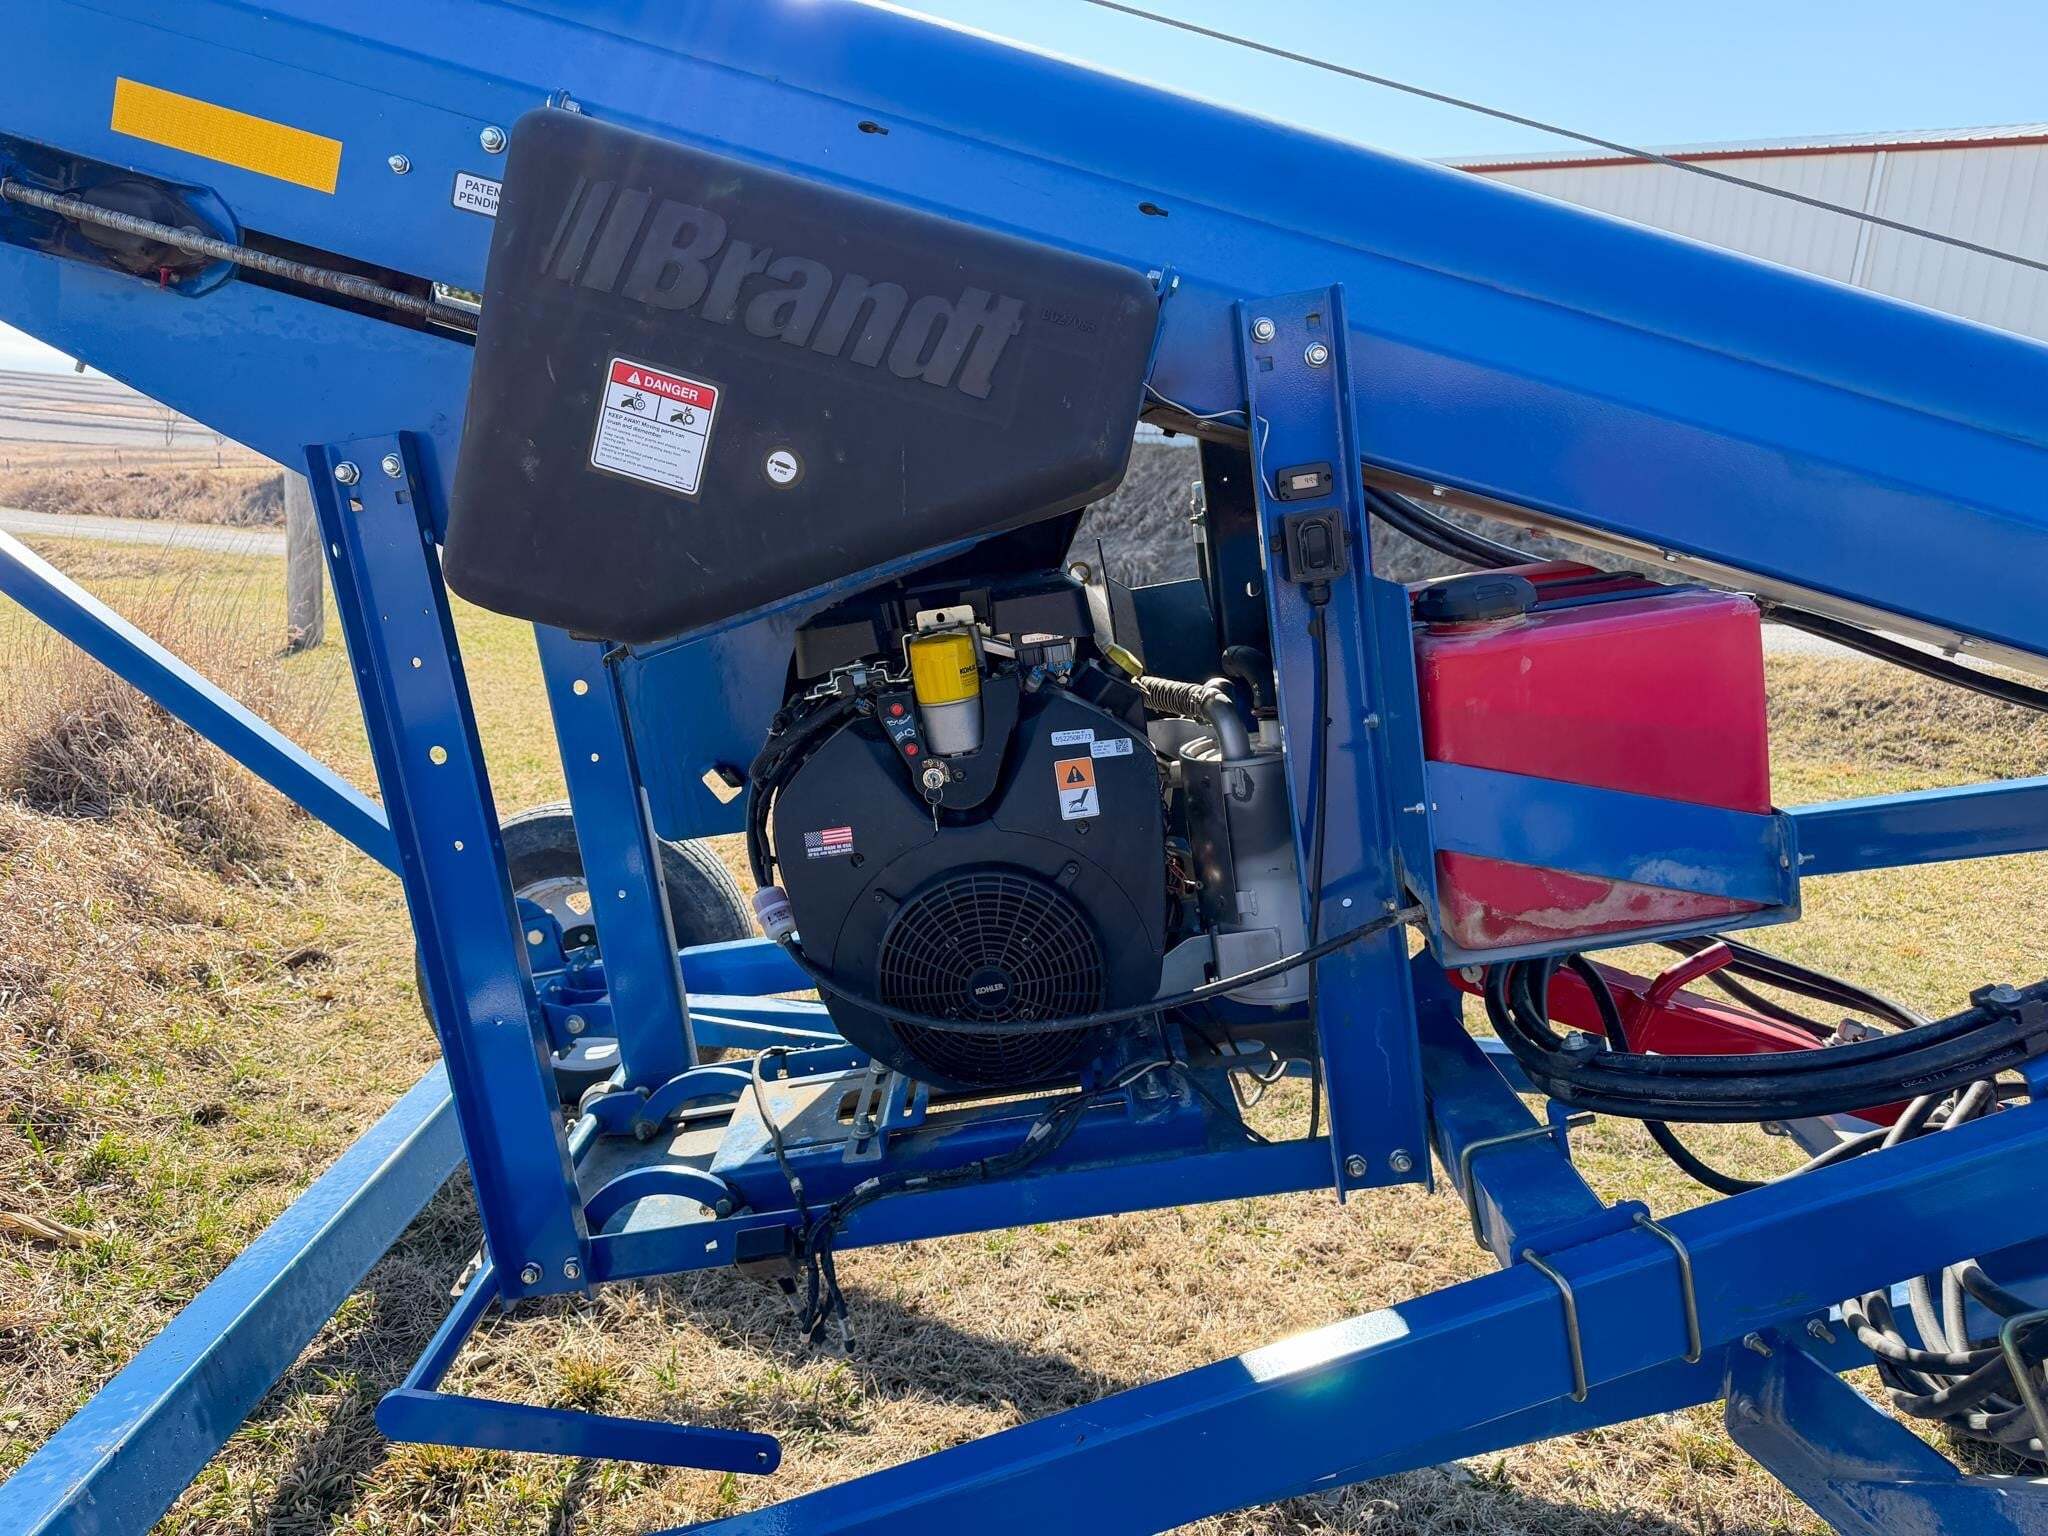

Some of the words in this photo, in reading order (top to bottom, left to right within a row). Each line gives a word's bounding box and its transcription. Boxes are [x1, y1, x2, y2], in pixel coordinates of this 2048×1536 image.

[465, 180, 501, 197] PATEN
[459, 191, 500, 210] PENDIN
[621, 199, 1024, 399] Brandt
[643, 376, 699, 401] DANGER
[608, 412, 623, 420] KEEP
[641, 422, 660, 432] Moving
[660, 427, 674, 436] parts
[975, 983, 1003, 995] KOHLER
